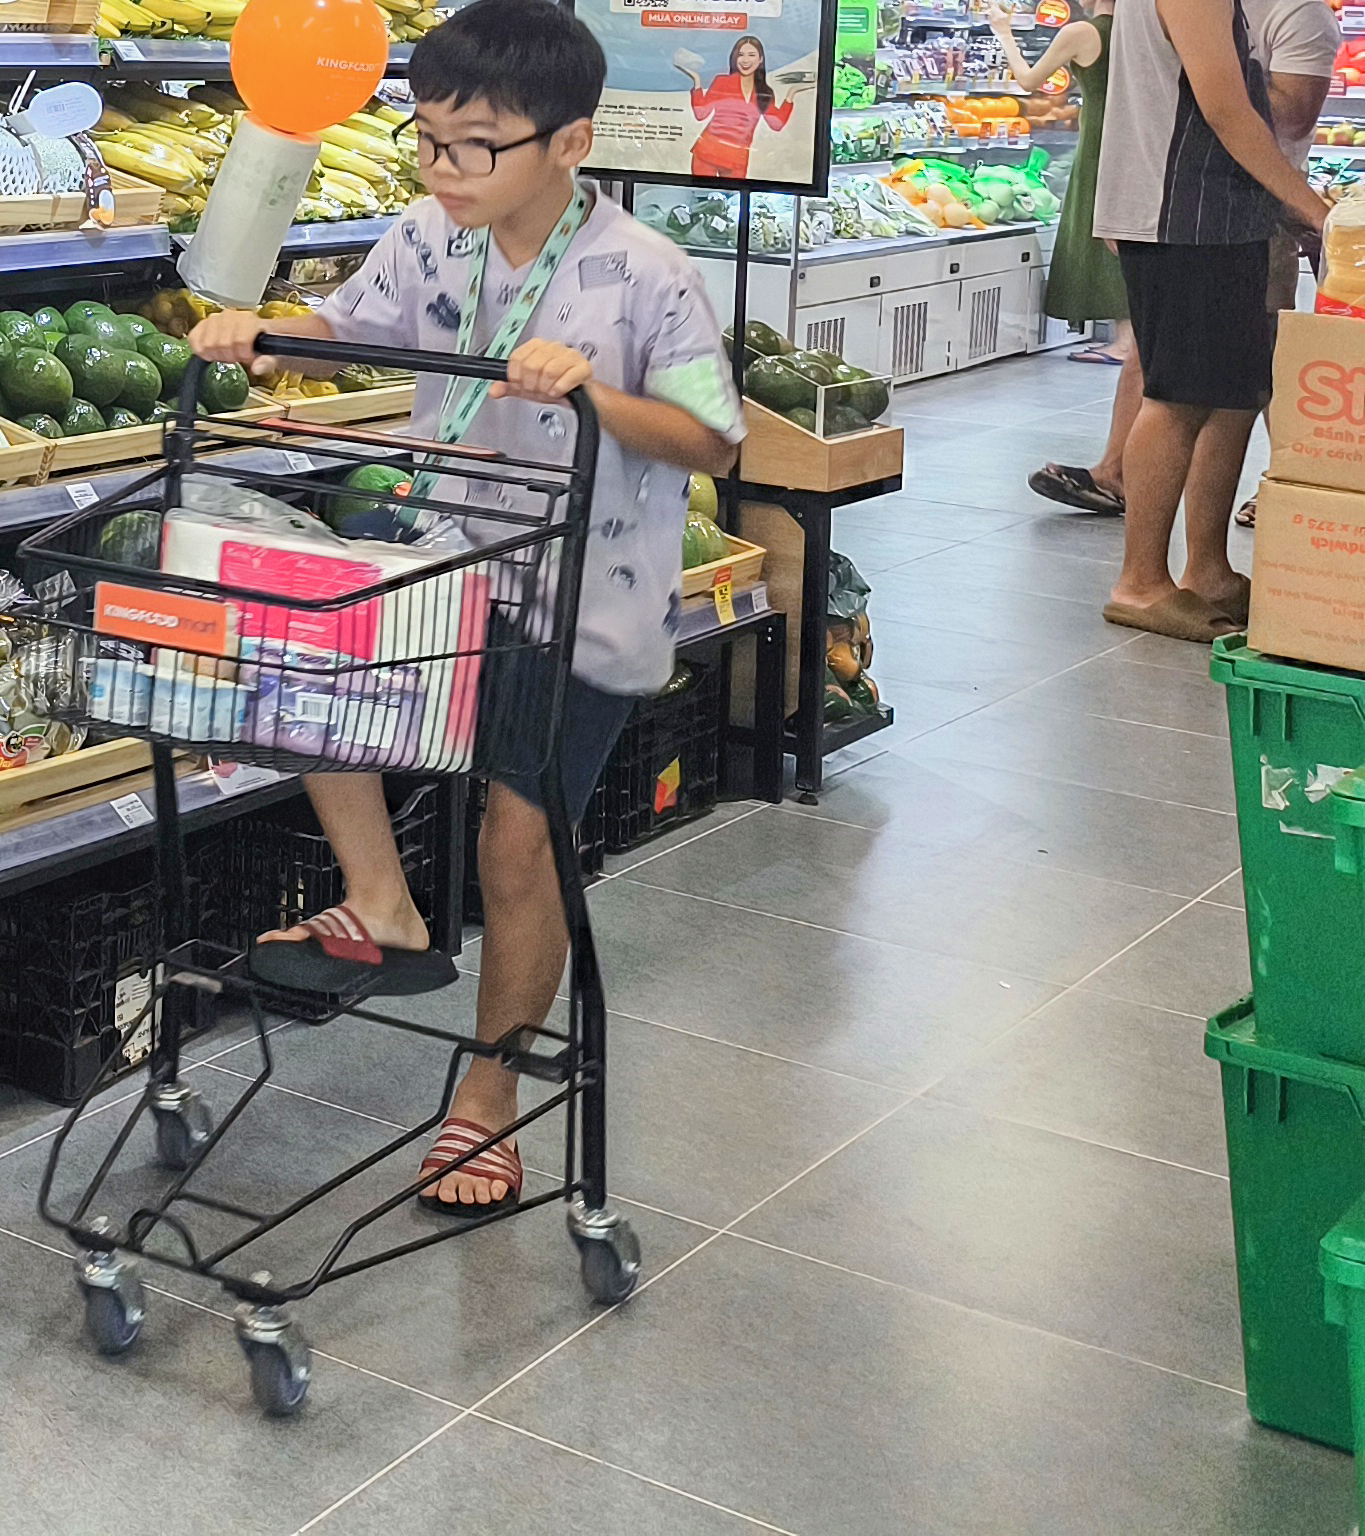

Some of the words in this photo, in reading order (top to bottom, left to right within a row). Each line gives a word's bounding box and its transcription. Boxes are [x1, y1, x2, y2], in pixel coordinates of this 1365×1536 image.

[648, 13, 672, 23] MUA
[673, 14, 709, 24] ONLINE
[712, 15, 741, 25] NGAY
